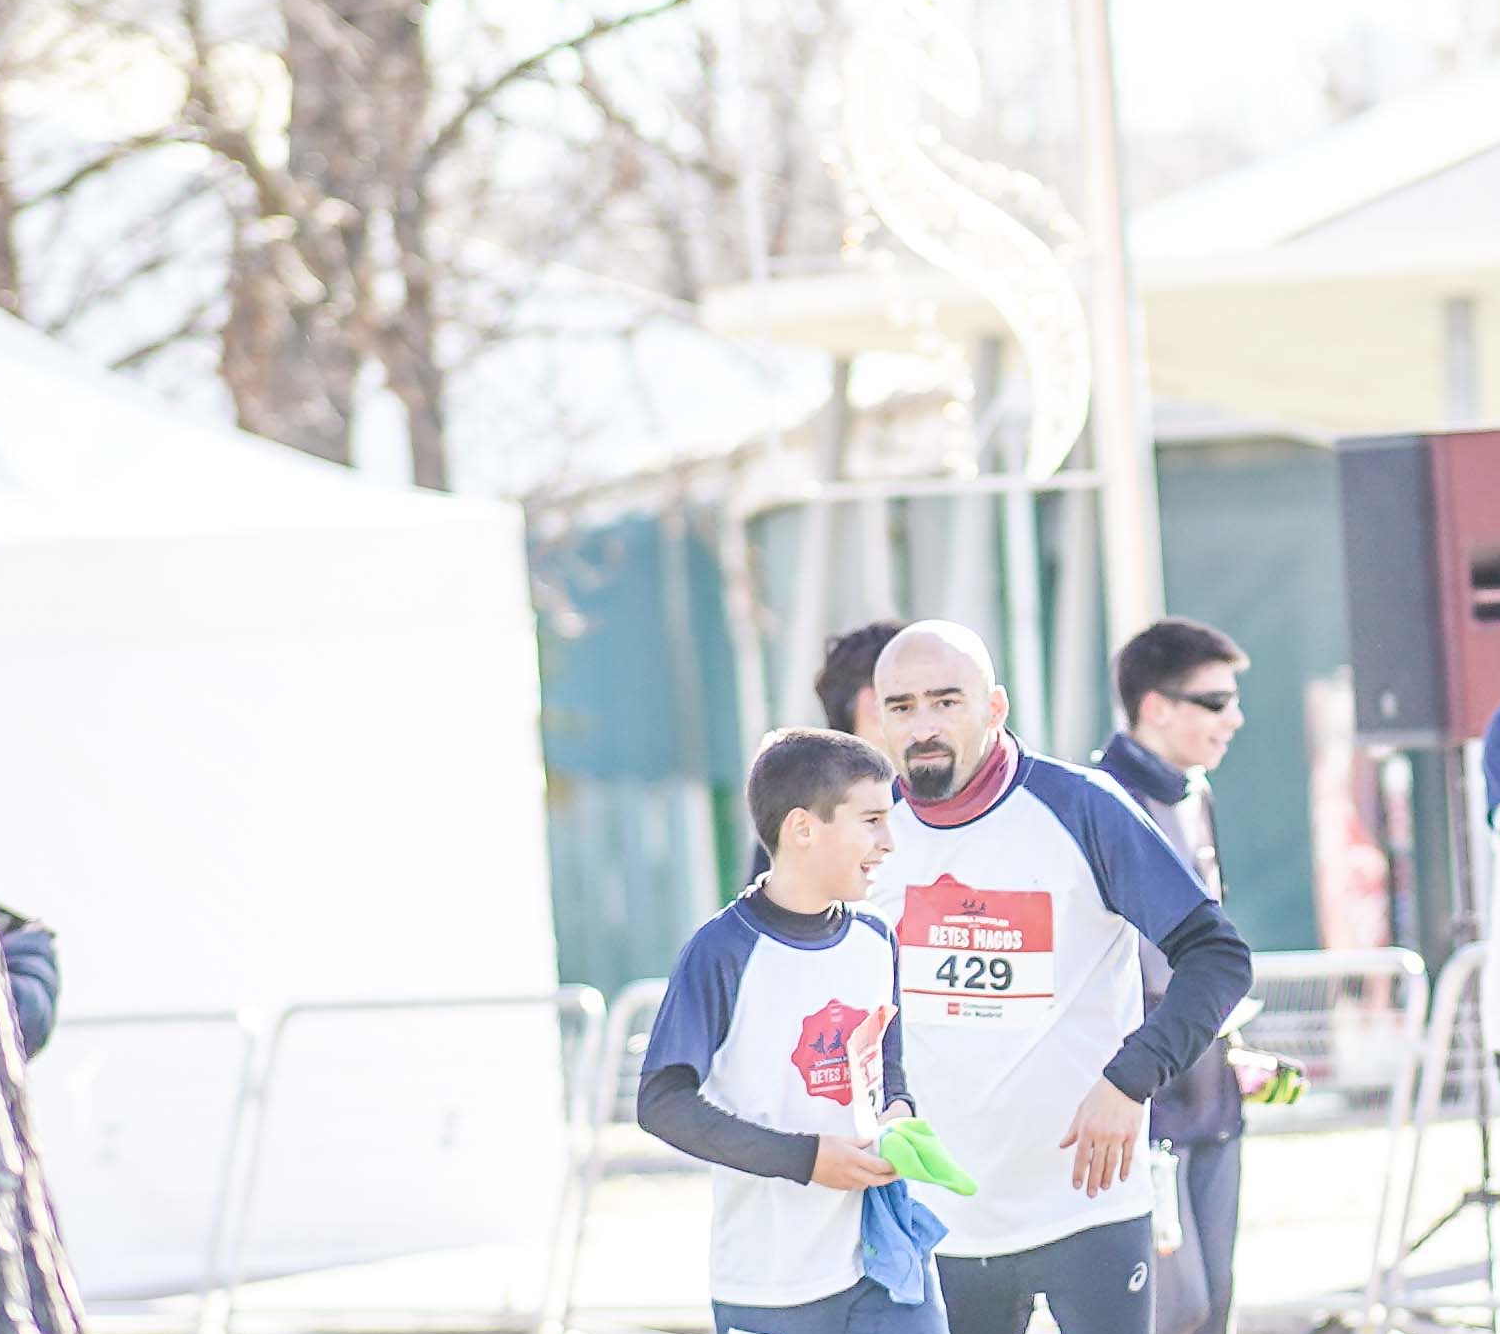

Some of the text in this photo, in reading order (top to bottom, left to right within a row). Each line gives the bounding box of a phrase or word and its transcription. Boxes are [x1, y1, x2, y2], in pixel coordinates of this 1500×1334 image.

[928, 924, 1023, 950] REYES MAGOS
[935, 954, 1014, 991] 429
